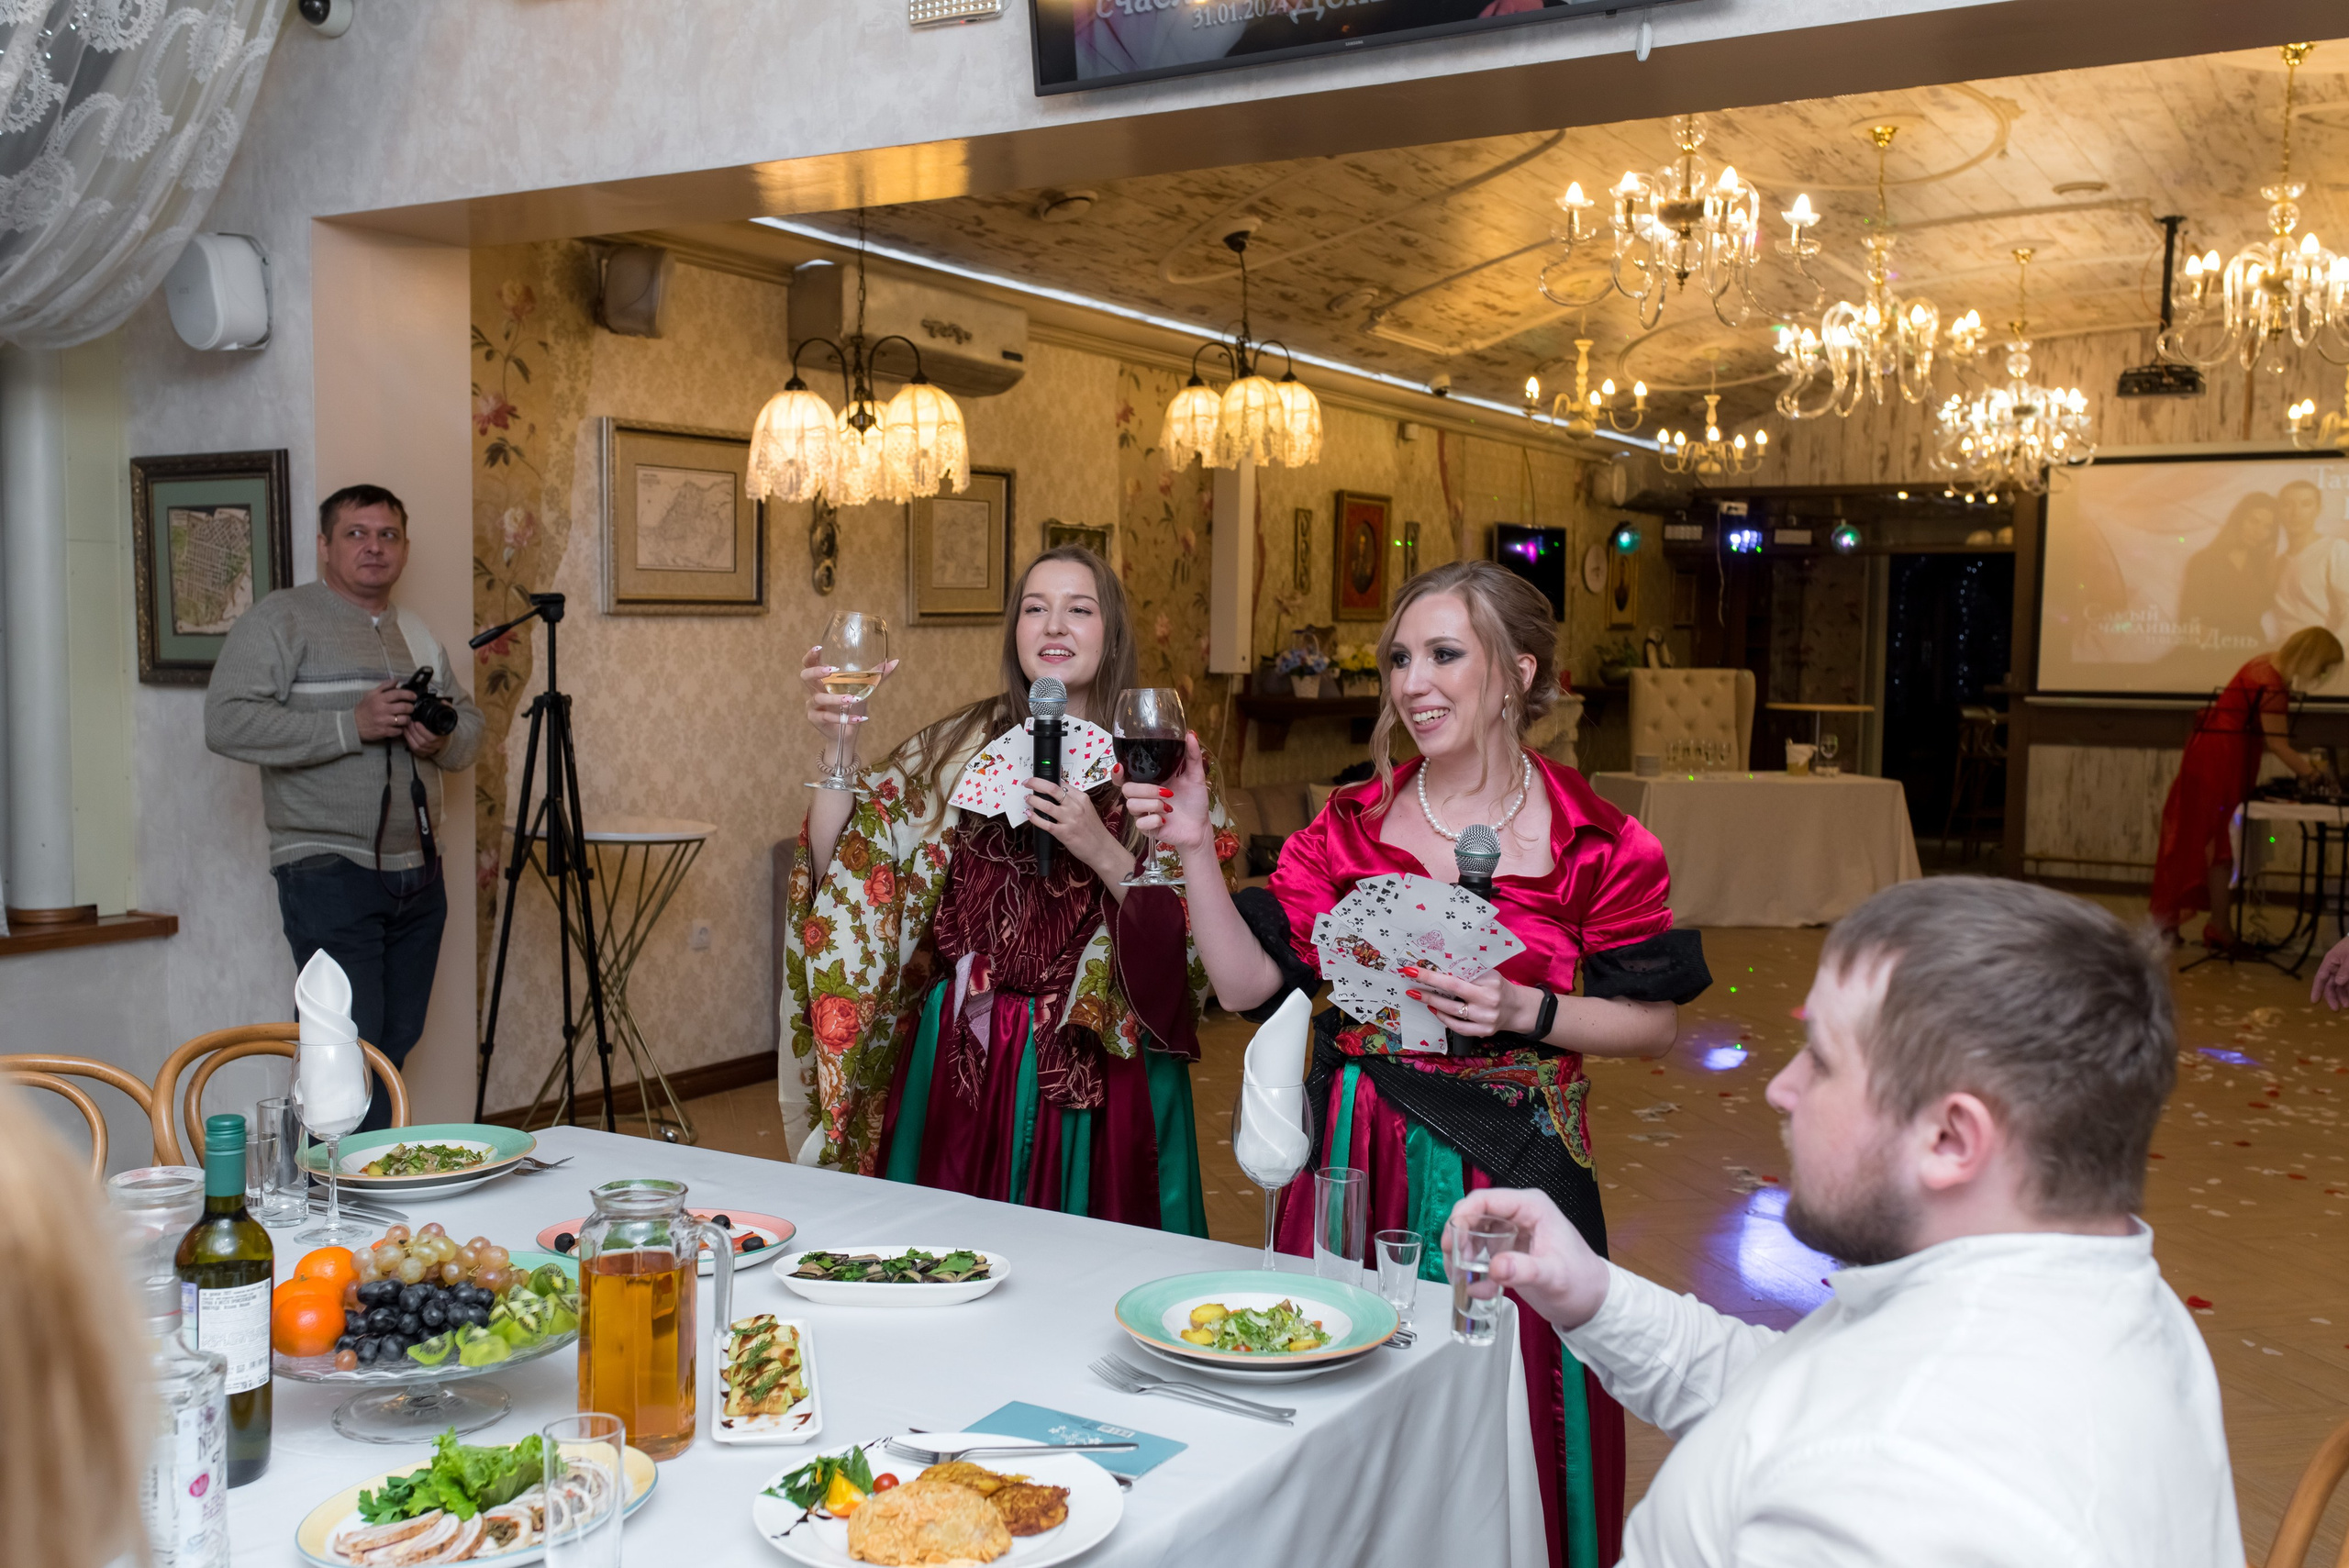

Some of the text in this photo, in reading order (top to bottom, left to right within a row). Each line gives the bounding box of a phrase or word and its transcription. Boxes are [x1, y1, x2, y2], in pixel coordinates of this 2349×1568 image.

[1359, 882, 1368, 890] 10
[1455, 888, 1464, 896] 6
[1346, 919, 1355, 928] 5
